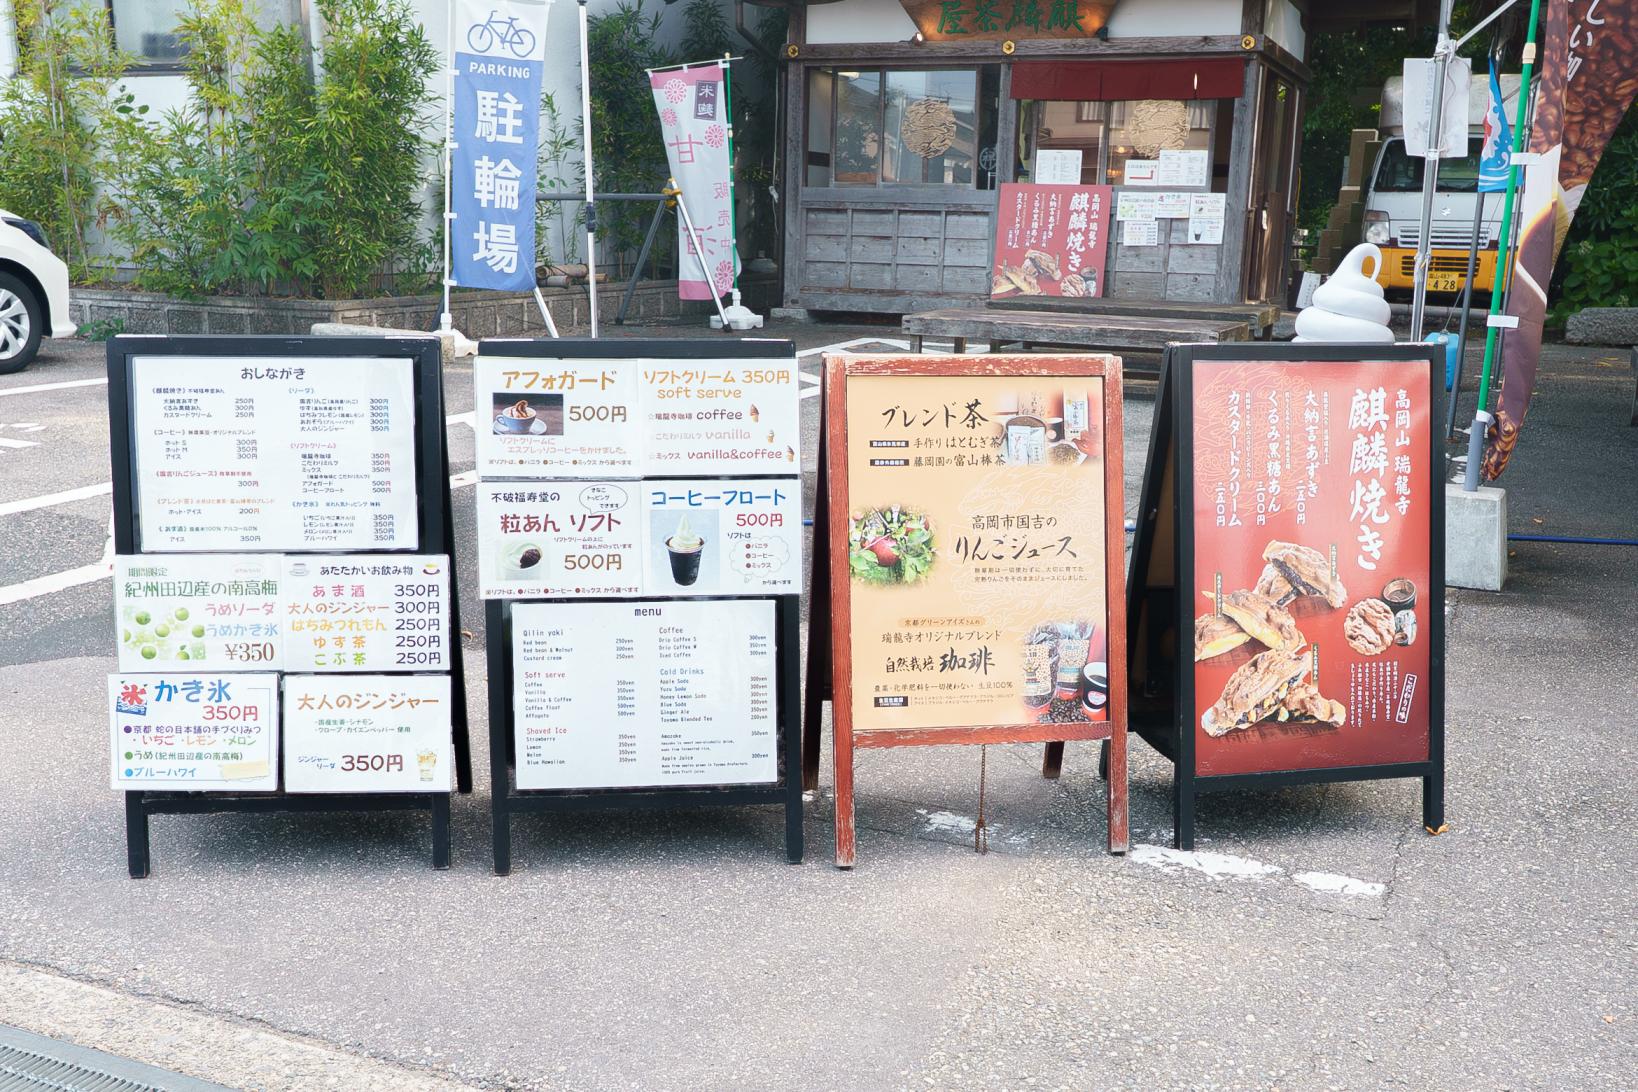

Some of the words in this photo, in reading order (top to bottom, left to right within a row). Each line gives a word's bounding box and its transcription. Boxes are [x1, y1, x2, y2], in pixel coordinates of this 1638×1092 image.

[469, 61, 531, 79] PARKING
[473, 89, 524, 275] 駐輪場
[1013, 191, 1024, 249] カスタードクリーム
[1066, 192, 1089, 272] 麒麟焼き
[241, 367, 306, 380] おしながき
[502, 370, 617, 391] アフォガード
[643, 370, 736, 385] ソフトクリーム
[741, 369, 790, 384] 350円
[656, 386, 692, 399] soft
[696, 388, 742, 399] serve
[569, 405, 627, 423] 500円
[696, 409, 743, 420] coffee
[881, 398, 989, 430] ブレンド茶
[1394, 388, 1411, 446] 高岡山
[705, 428, 751, 440] vanilla
[499, 437, 556, 446] ソフトクリームに
[913, 437, 1002, 449] 手作りはとむぎ茶
[1303, 389, 1320, 498] 大納言あずき
[655, 452, 681, 460] ミックス
[687, 448, 783, 460] vanilla&coffee
[1227, 390, 1242, 527] カスタードクリーム
[1266, 390, 1282, 513] くるみ黒糖あん
[914, 454, 1007, 467] 藤岡園の富山棒茶
[1348, 386, 1390, 571] 麒麟焼き
[1394, 455, 1411, 516] 瑞龍寺
[491, 491, 560, 503] 不破福寿堂の
[651, 488, 787, 506] コーヒーフロート
[500, 513, 561, 534] 粒あん
[570, 512, 621, 533] ソフト
[736, 513, 783, 528] 500円
[972, 514, 1058, 530] 高岡市国吉の
[955, 534, 1077, 564] りんごジュース
[564, 553, 622, 571] 500円
[128, 567, 168, 577] 期間限定
[320, 565, 413, 576] あたたかいお飲み物
[124, 579, 278, 597] 紀州田辺産の南高梅
[312, 584, 365, 597] あま酒
[394, 584, 440, 597] 350円
[205, 602, 276, 616] うめソーダ
[287, 602, 390, 615] 大人のジンジャー
[394, 601, 440, 614] 300円
[634, 608, 662, 617] menu
[206, 623, 278, 637] うめかき氷
[291, 618, 387, 631] はちみつれもん
[395, 618, 440, 631] 250円
[523, 629, 544, 637] Qilin
[881, 631, 1002, 644] 瑞龍寺オリジナルブレンド
[313, 635, 366, 649] ゆず茶
[395, 635, 441, 648] 250円
[224, 642, 275, 662] ¥350
[314, 652, 366, 666] こぶ茶
[395, 652, 441, 665] 250円
[886, 655, 934, 673] 自然栽培
[939, 645, 995, 675] 珈琲
[525, 671, 541, 679] Soft
[660, 668, 676, 676] Cold
[154, 679, 232, 703] かき氷
[297, 692, 440, 711] 大人のジンジャー
[202, 705, 258, 722] 350円
[133, 725, 152, 734] 京都
[526, 727, 551, 735] Shaved
[555, 727, 567, 735] Ice
[298, 755, 329, 763] ジンジャー
[341, 754, 404, 773] 350円
[134, 767, 197, 778] ブルーハワイ
